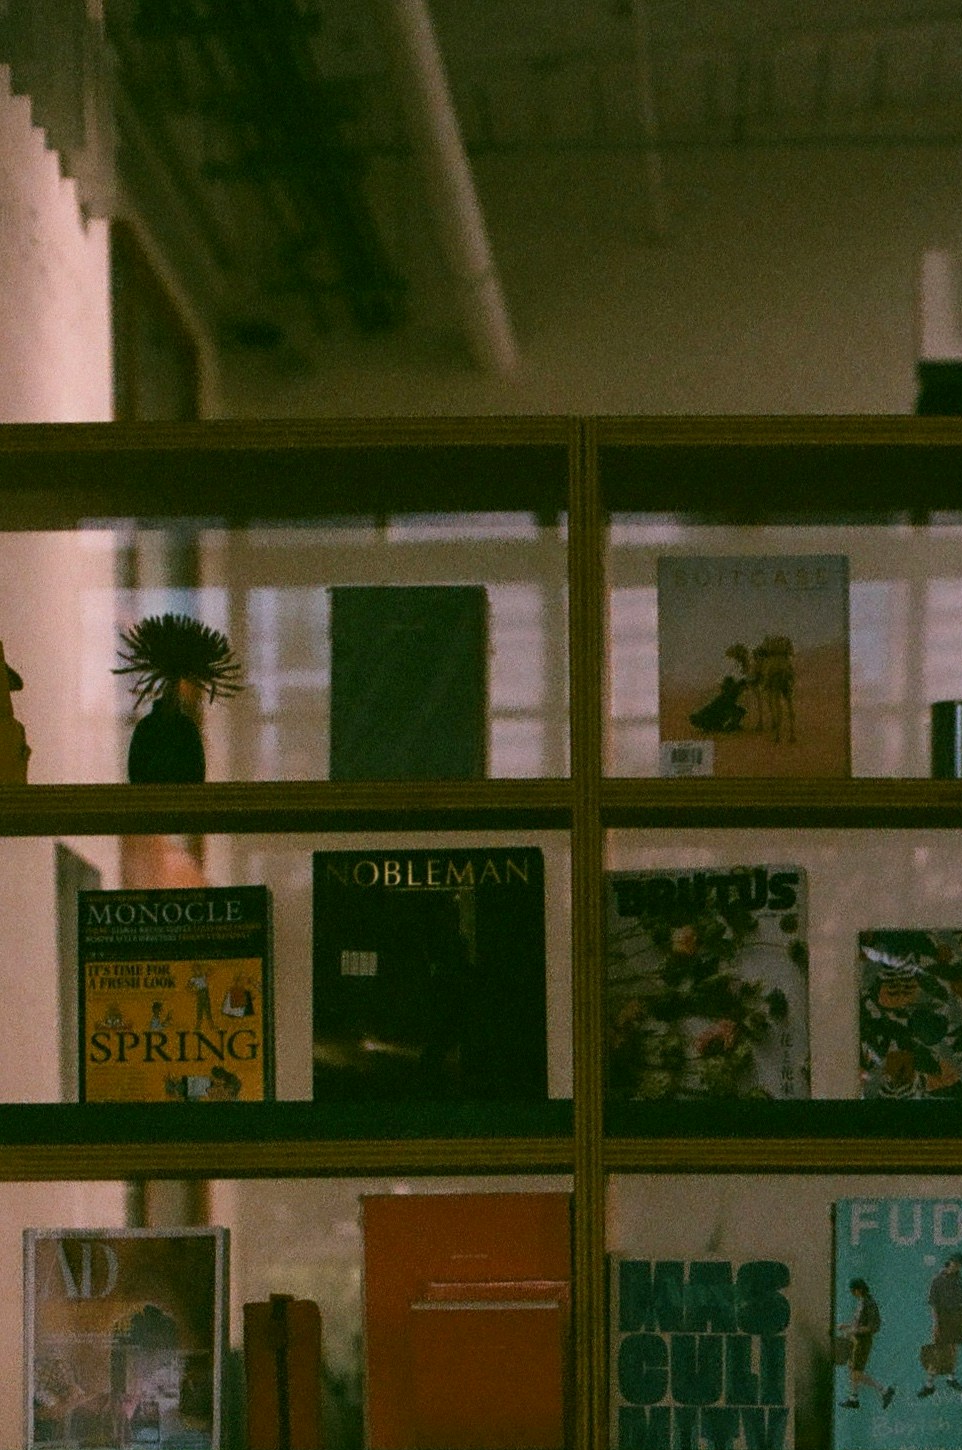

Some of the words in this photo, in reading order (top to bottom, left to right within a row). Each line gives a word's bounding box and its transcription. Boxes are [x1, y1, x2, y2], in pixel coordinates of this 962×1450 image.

[326, 858, 529, 887] NOBLEMAN
[87, 900, 243, 925] MONOCLE
[90, 1029, 258, 1063] SPRING
[46, 1242, 118, 1299] AD
